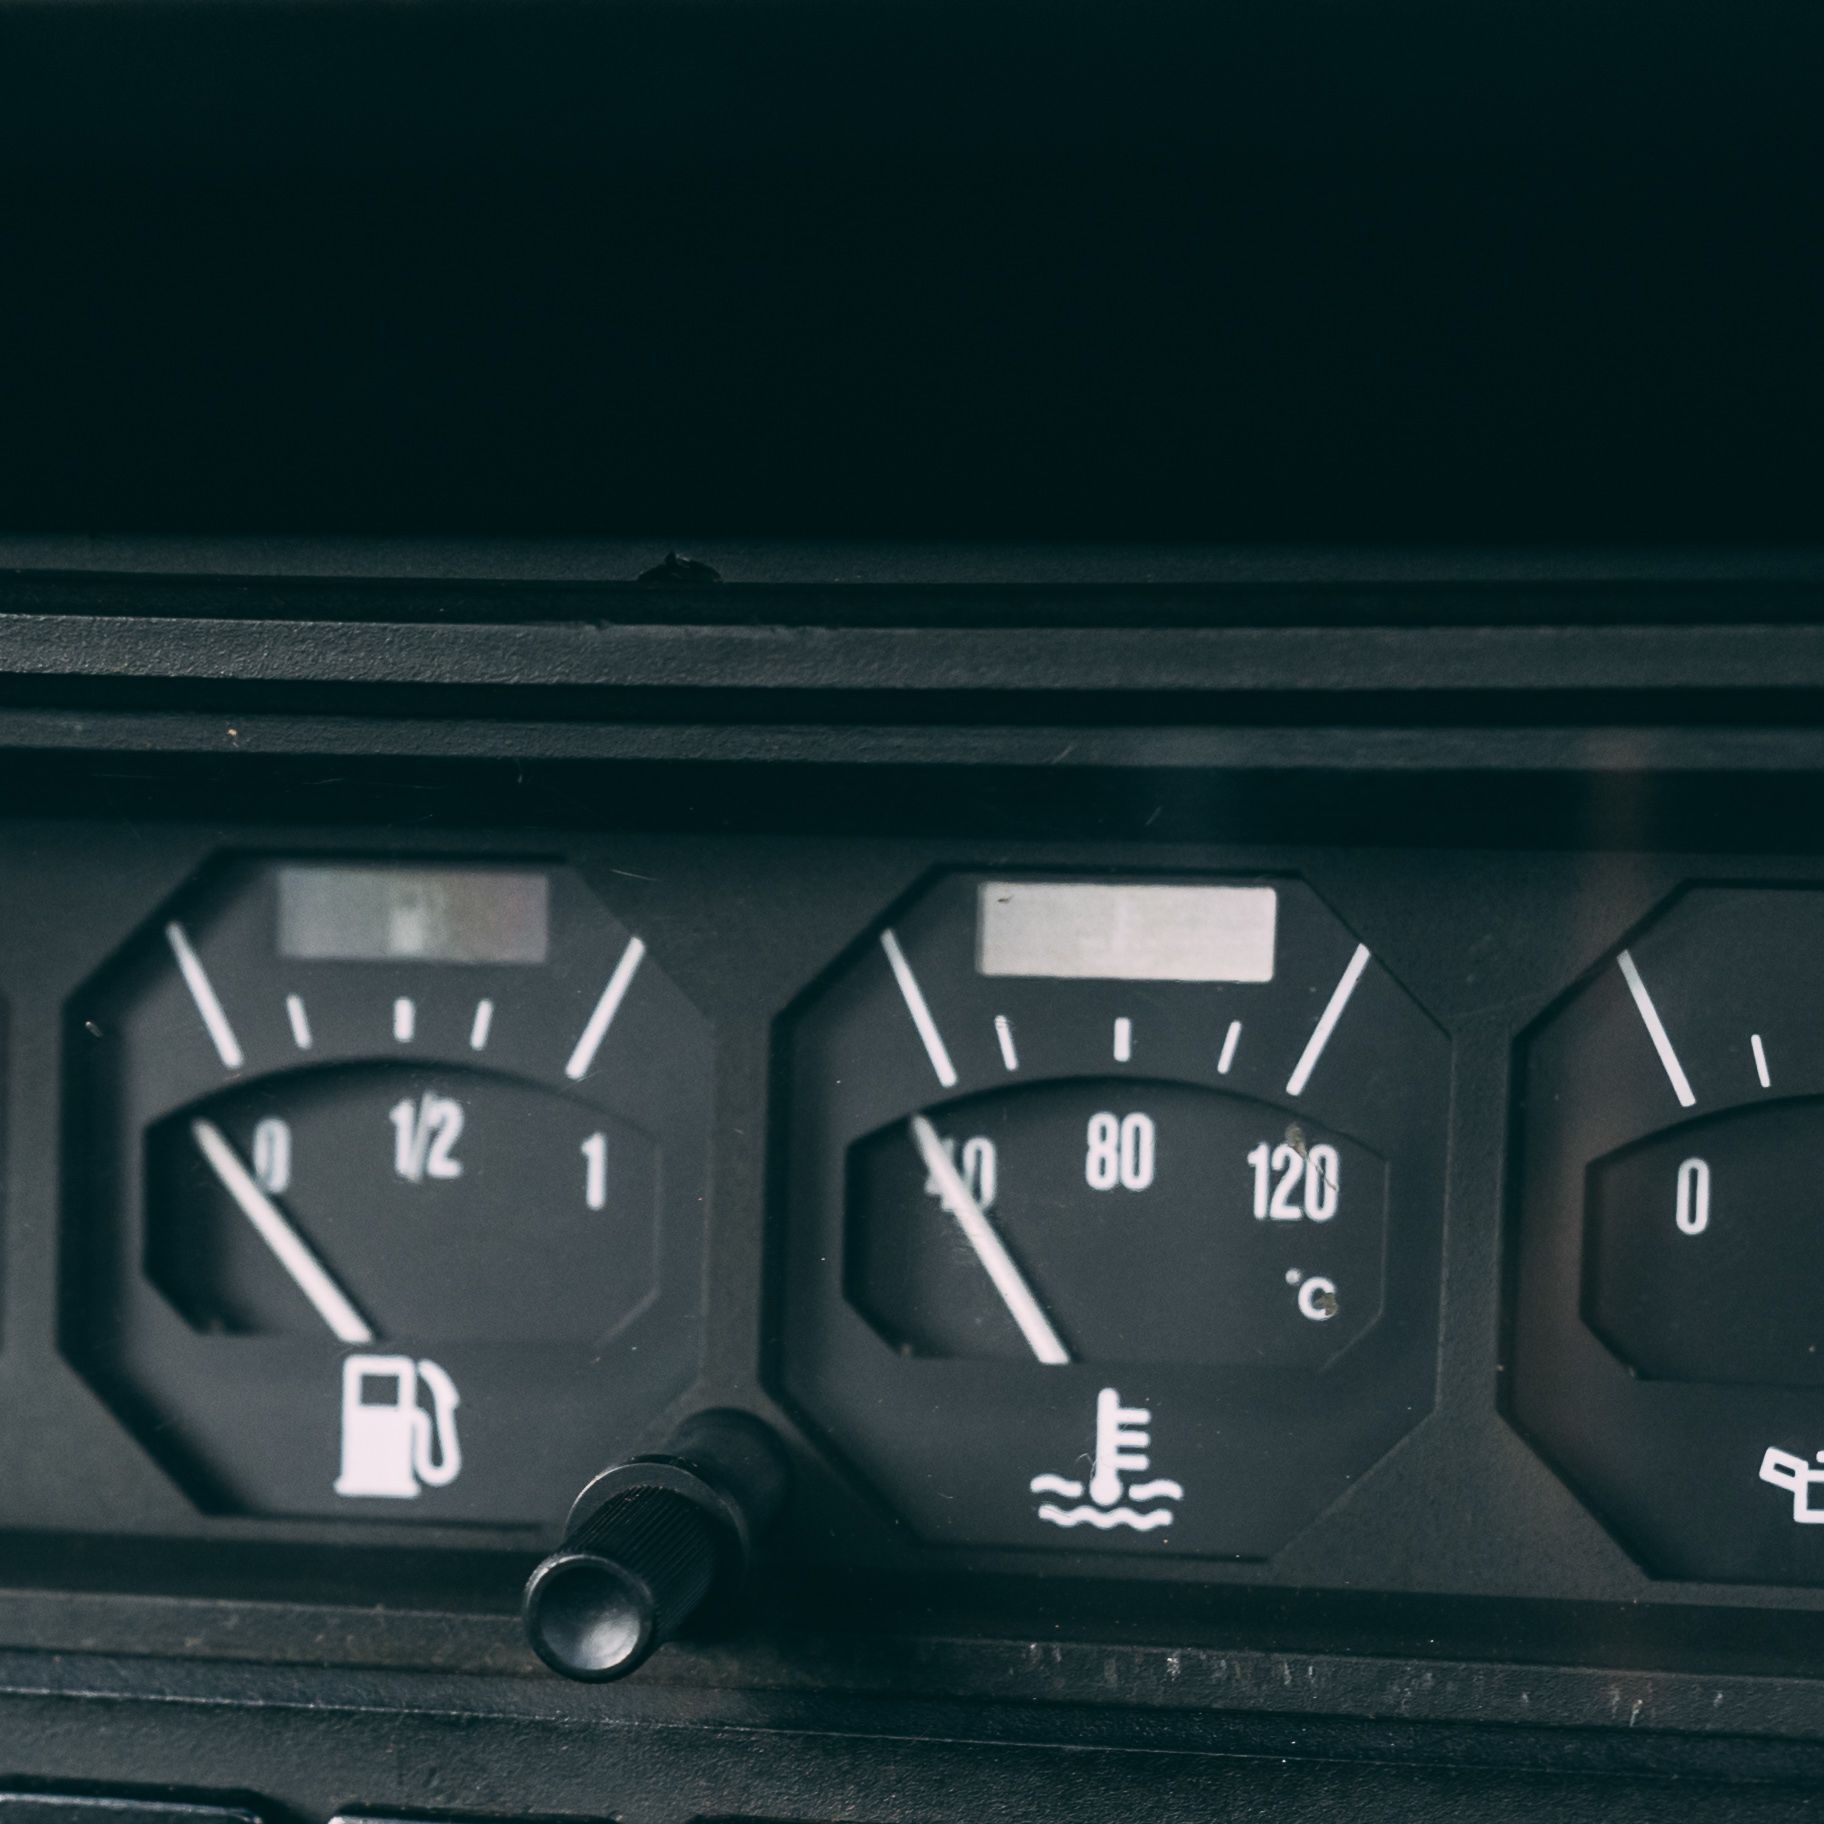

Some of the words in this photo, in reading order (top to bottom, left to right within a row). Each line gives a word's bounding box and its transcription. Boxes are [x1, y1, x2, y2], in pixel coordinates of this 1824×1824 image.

[254, 1119, 291, 1194] 0
[390, 1090, 464, 1182] 1/2
[582, 1133, 607, 1210] 1
[1086, 1112, 1155, 1191] 80
[1247, 1143, 1340, 1221] 120
[1676, 1158, 1710, 1235] 0
